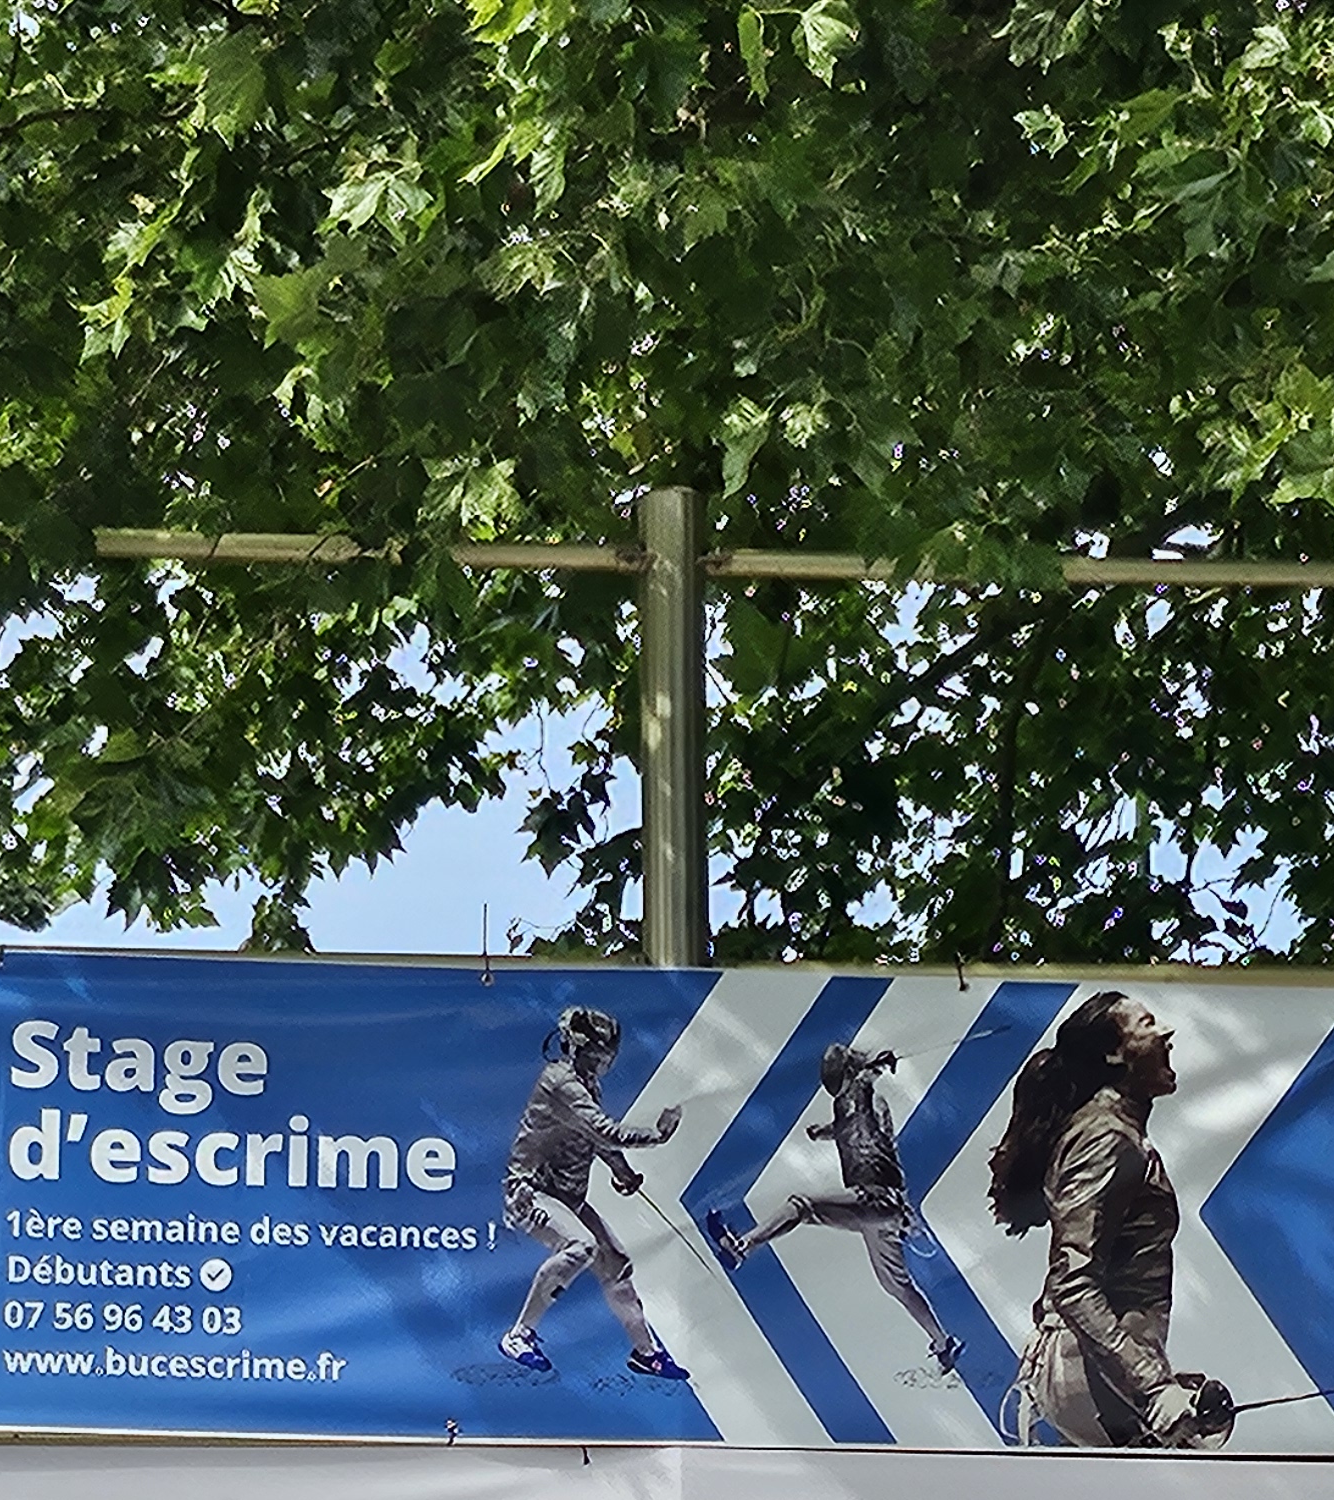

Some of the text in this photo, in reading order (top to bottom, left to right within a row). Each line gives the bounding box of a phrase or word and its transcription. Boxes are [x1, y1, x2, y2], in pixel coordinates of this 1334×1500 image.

[10, 1018, 269, 1116] Stage
[8, 1107, 458, 1191] d'escrime
[5, 1209, 83, 1242] 1ère
[91, 1213, 240, 1246] semaine
[250, 1217, 309, 1248] des
[320, 1223, 478, 1250] vacances
[7, 1254, 192, 1289] Débutants
[4, 1301, 243, 1335] 07 56 96 43 03
[3, 1347, 349, 1382] www.bucescrime.fr
